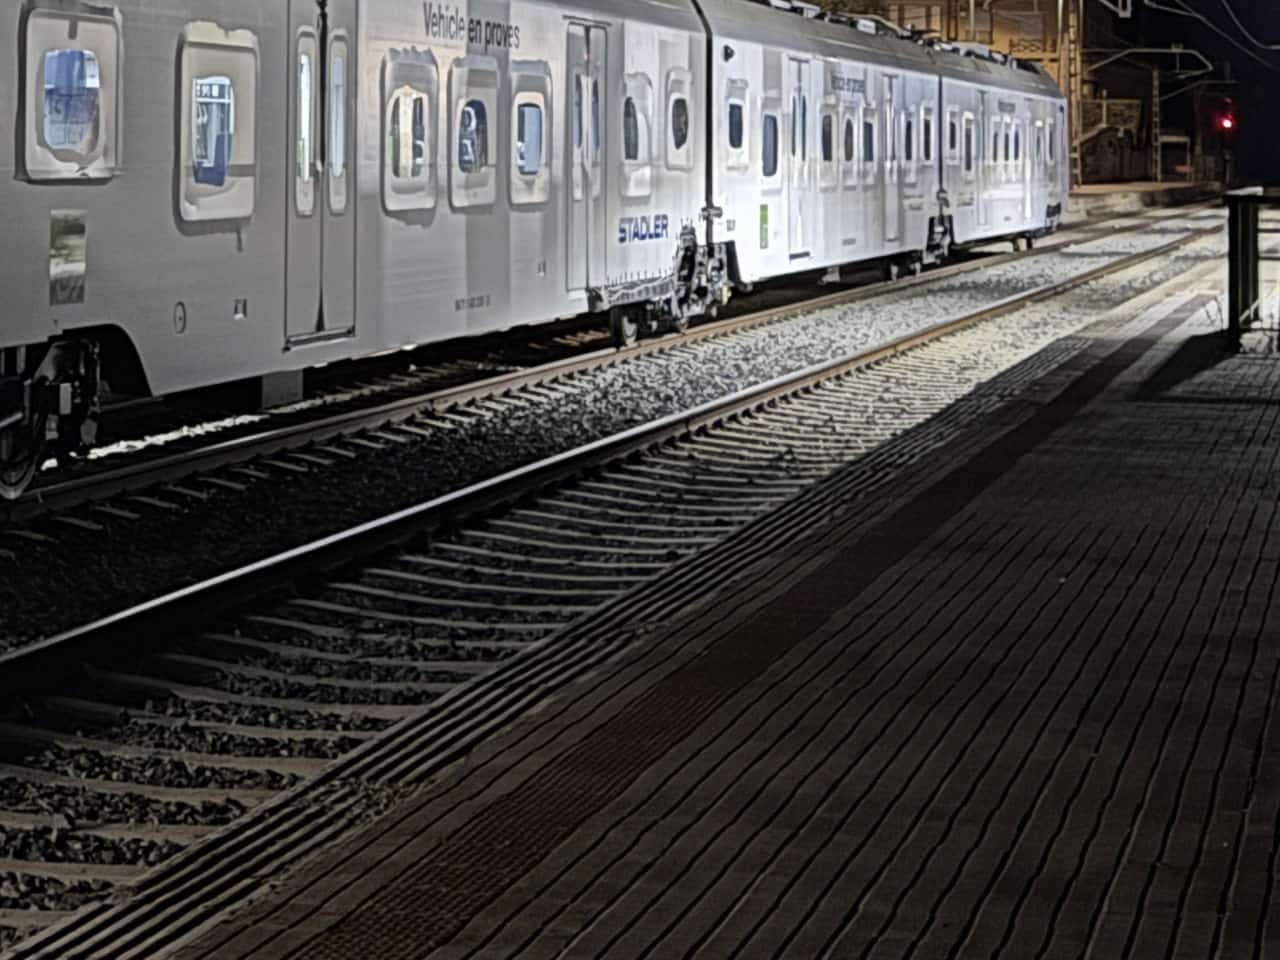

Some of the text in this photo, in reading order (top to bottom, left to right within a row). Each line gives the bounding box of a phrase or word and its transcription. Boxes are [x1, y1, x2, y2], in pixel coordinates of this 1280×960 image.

[423, 1, 521, 55] Vehicle en proves
[618, 214, 669, 243] STADLER
